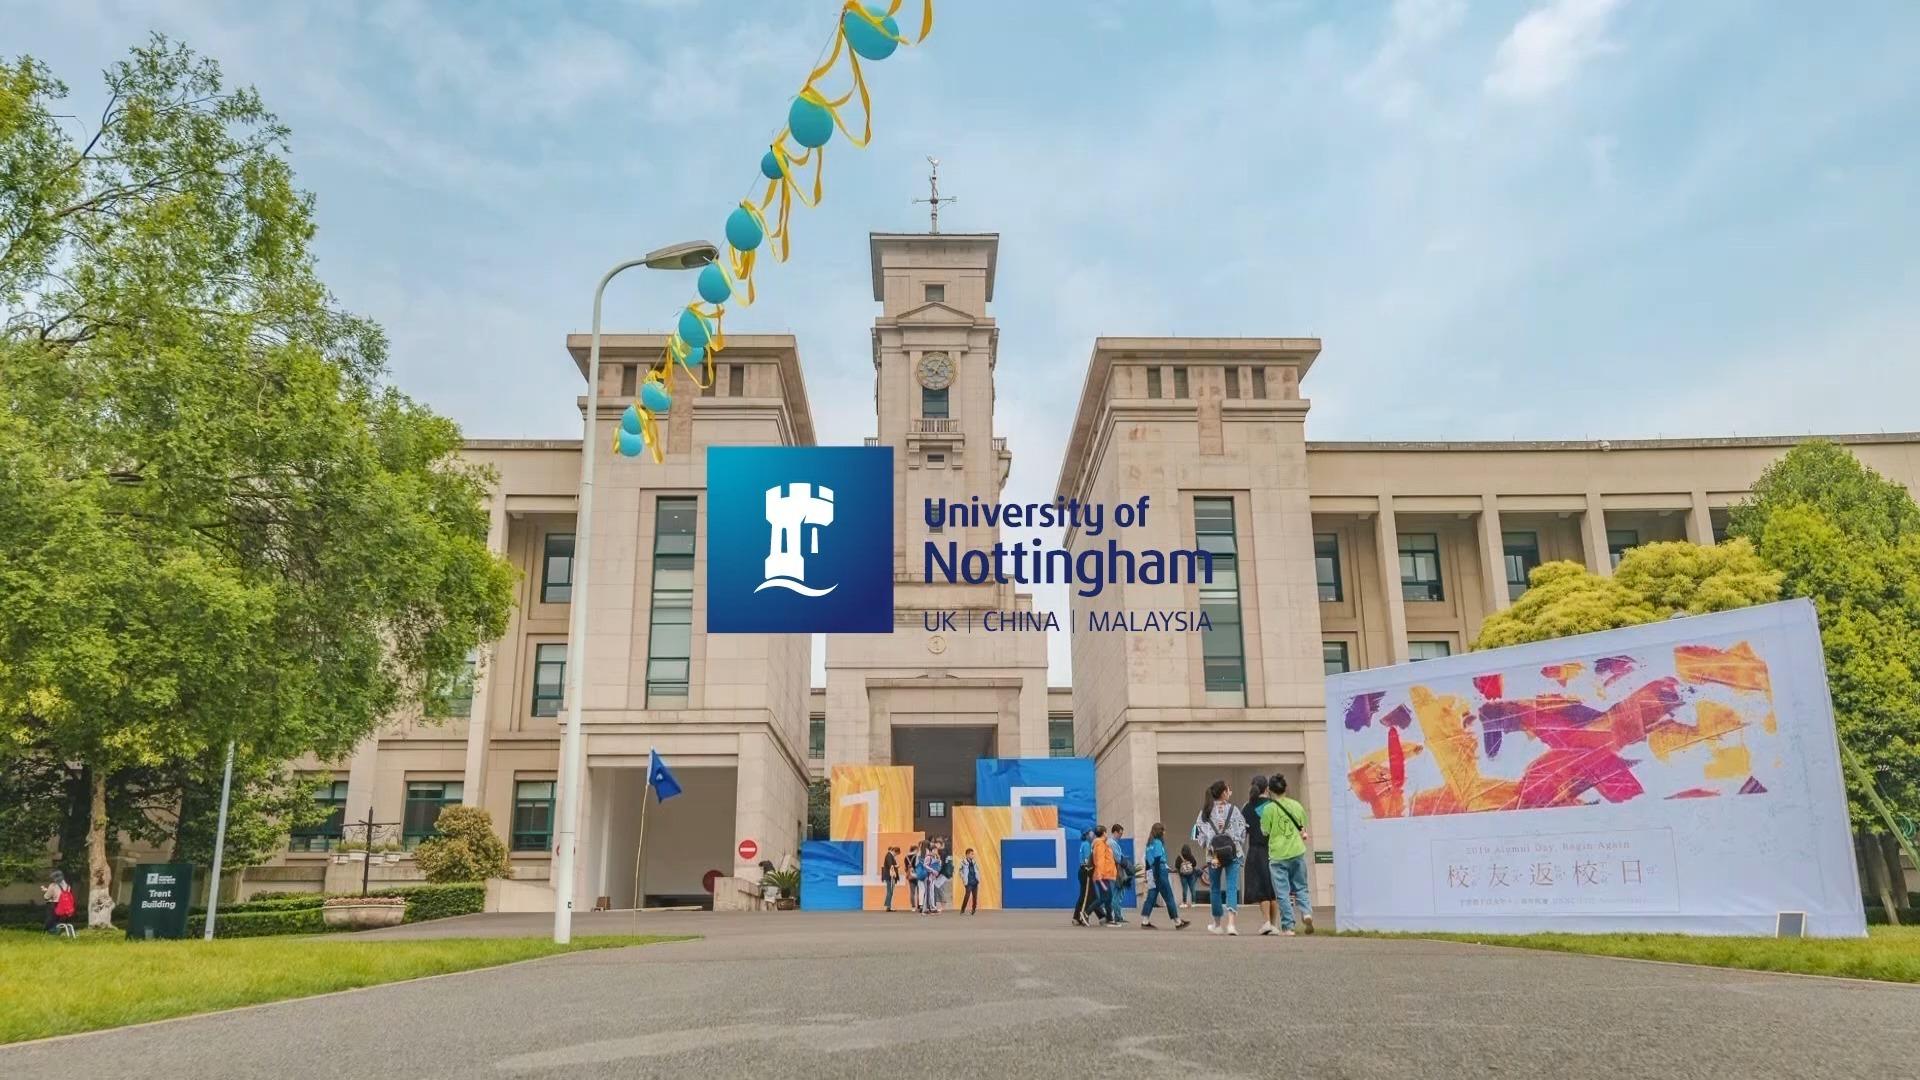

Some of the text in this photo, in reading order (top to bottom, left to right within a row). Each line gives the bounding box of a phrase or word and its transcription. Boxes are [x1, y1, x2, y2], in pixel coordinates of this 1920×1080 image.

[1447, 859, 1643, 889] 校友返校日
[148, 889, 172, 898] Trent
[141, 900, 176, 910] Building
